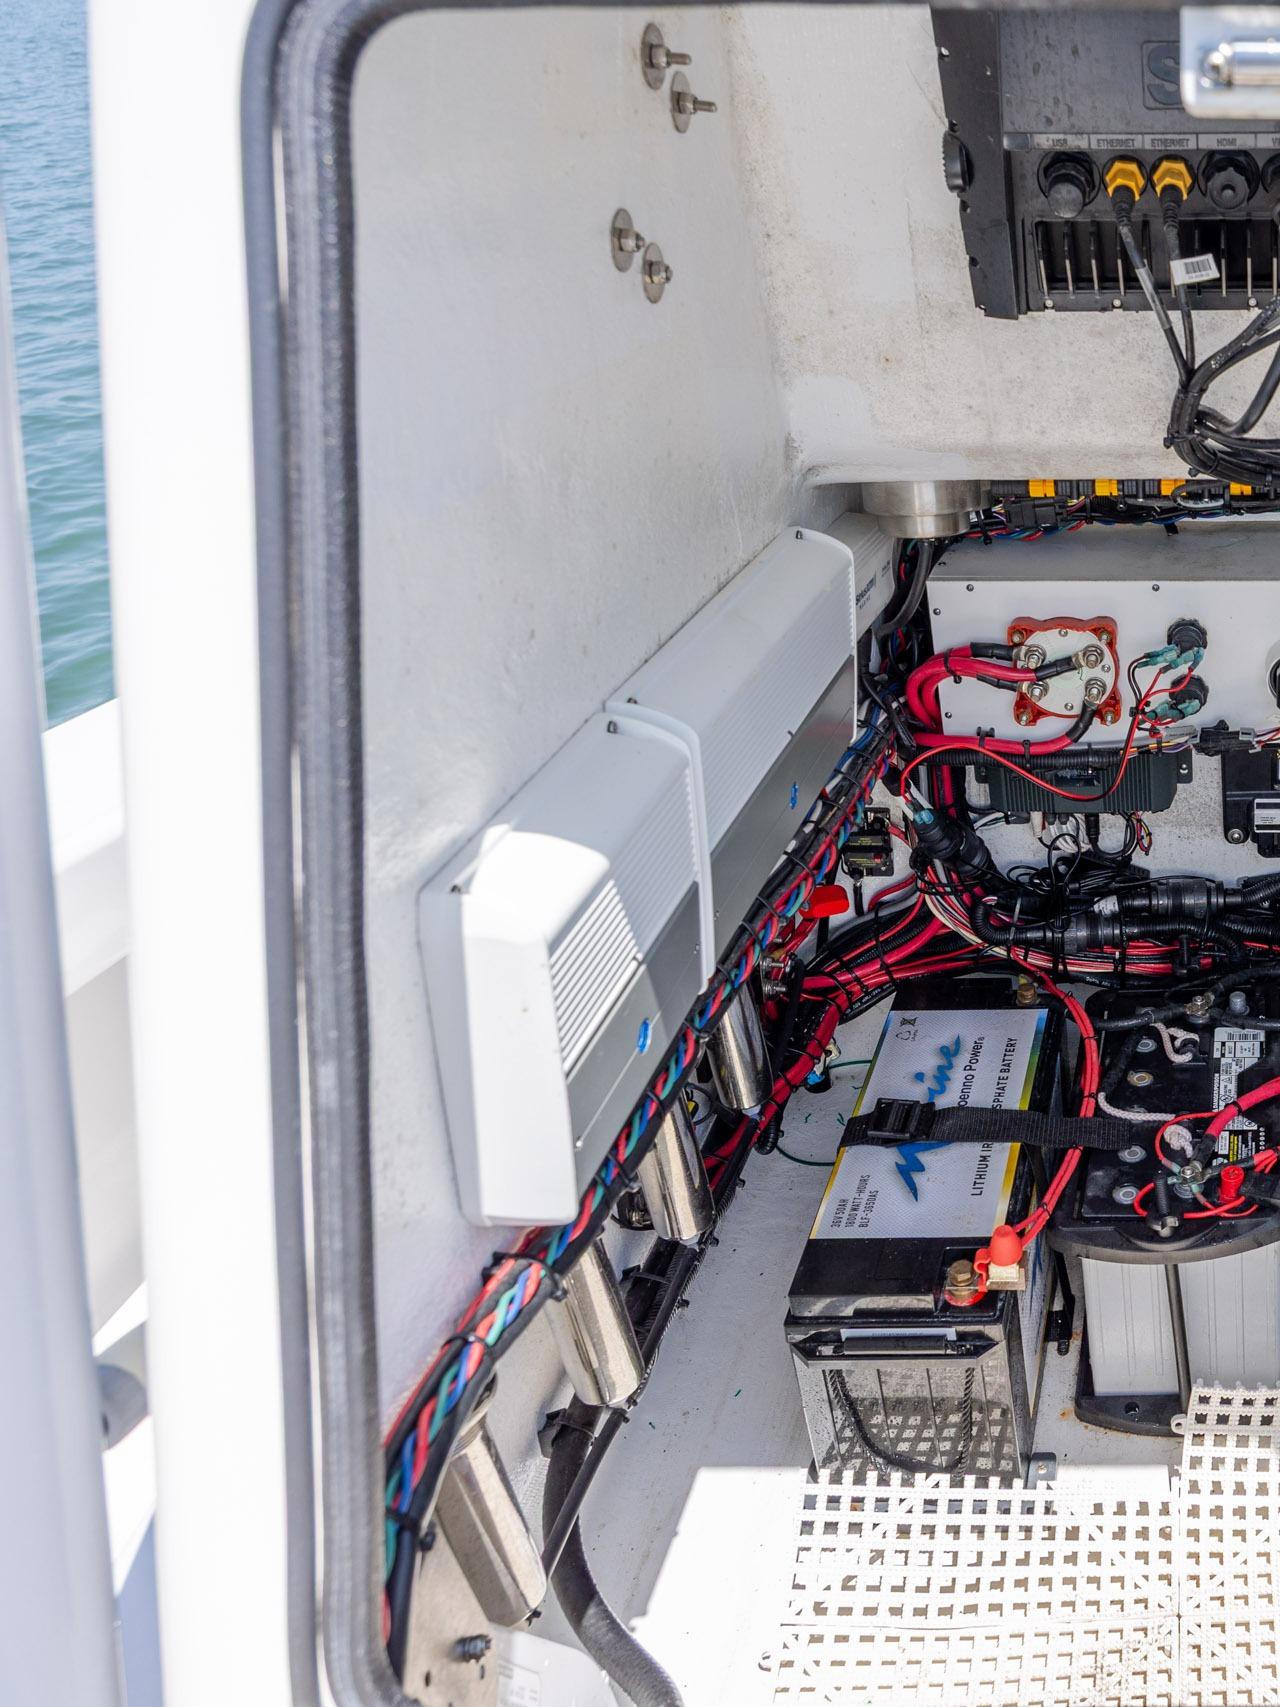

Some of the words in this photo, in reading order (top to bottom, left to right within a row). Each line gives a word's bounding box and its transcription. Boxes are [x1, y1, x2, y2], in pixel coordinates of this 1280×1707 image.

[1096, 138, 1136, 148] ETHERNET
[1151, 138, 1190, 148] ETHERNET
[971, 1152, 990, 1197] LITHIUM
[1000, 1037, 1018, 1076] BATTERY
[849, 1174, 871, 1212] WATT-HOURS
